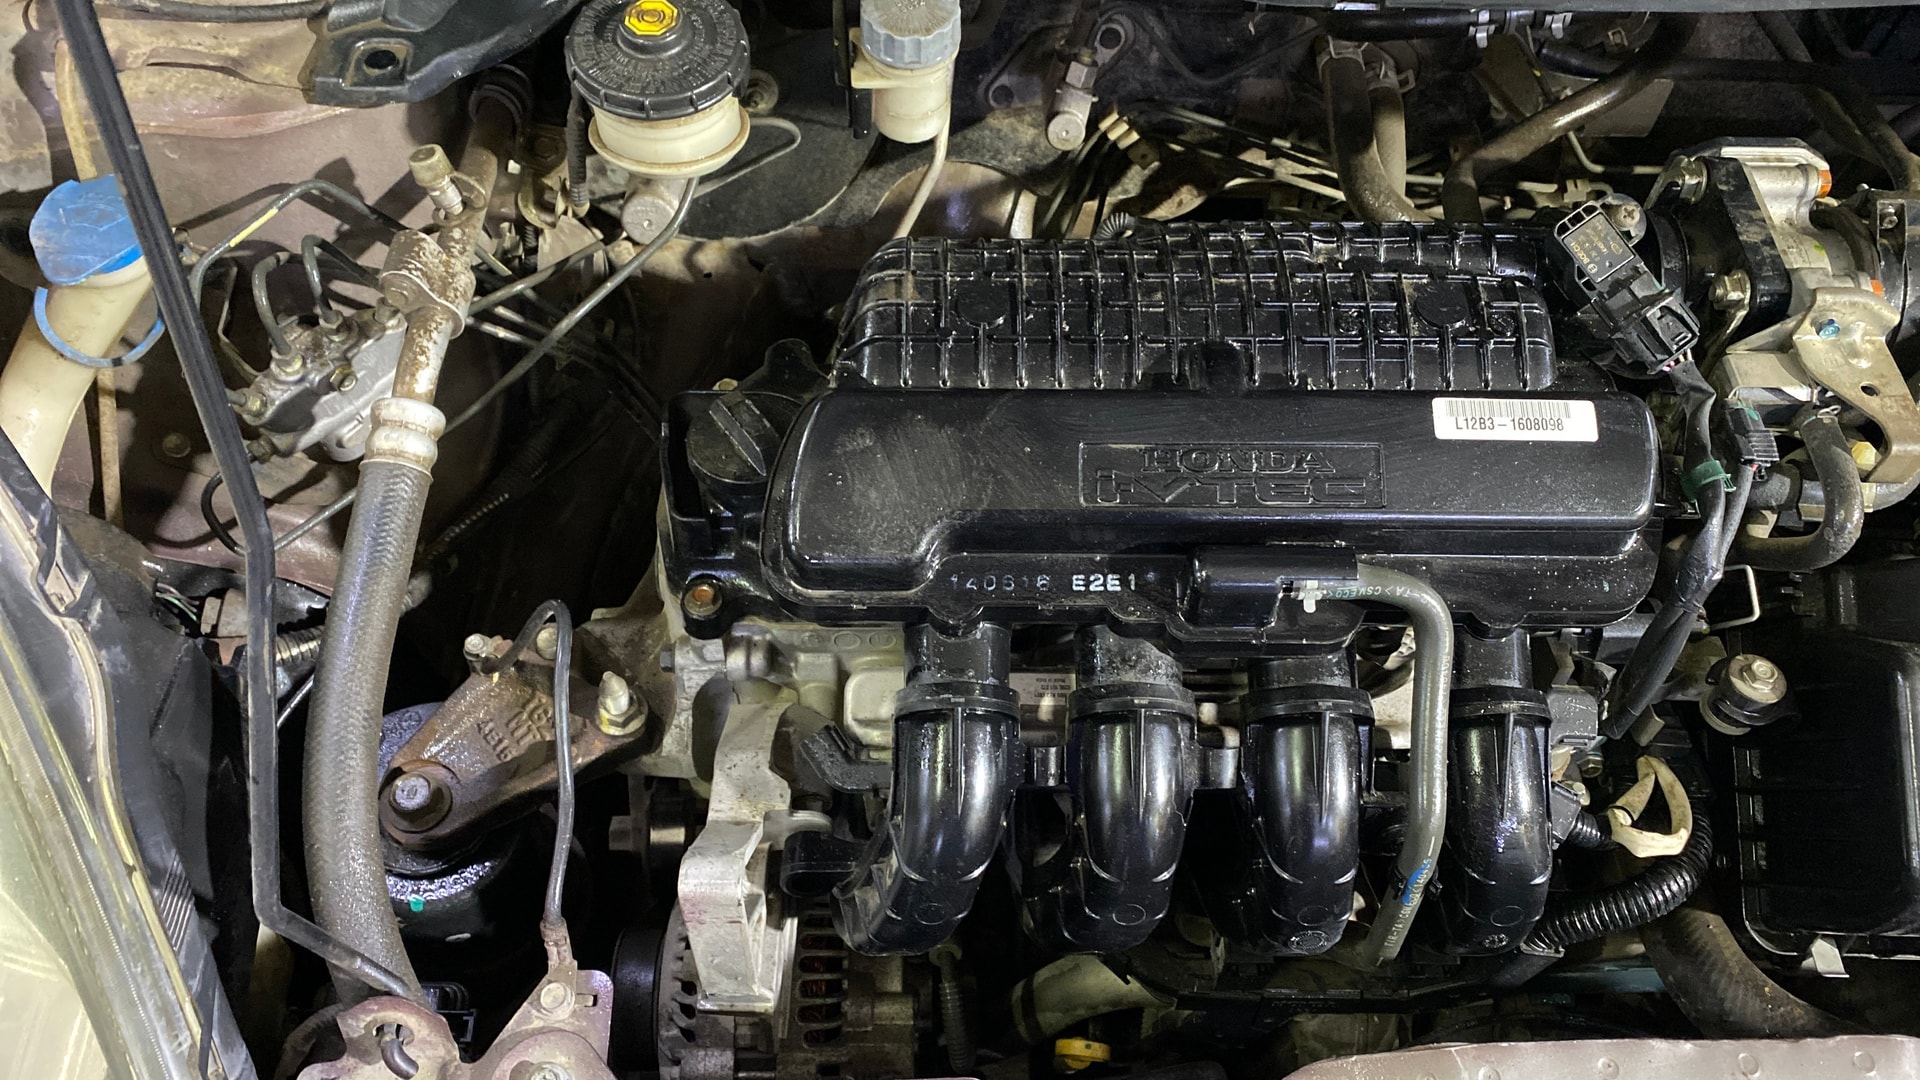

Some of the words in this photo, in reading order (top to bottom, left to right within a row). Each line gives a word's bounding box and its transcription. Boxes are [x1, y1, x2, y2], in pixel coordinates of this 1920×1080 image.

[1570, 241, 1590, 264] BOSCH
[1455, 417, 1564, 431] L12B3-1608098
[1139, 447, 1335, 474] HONDA
[1071, 572, 1136, 592] E2E1
